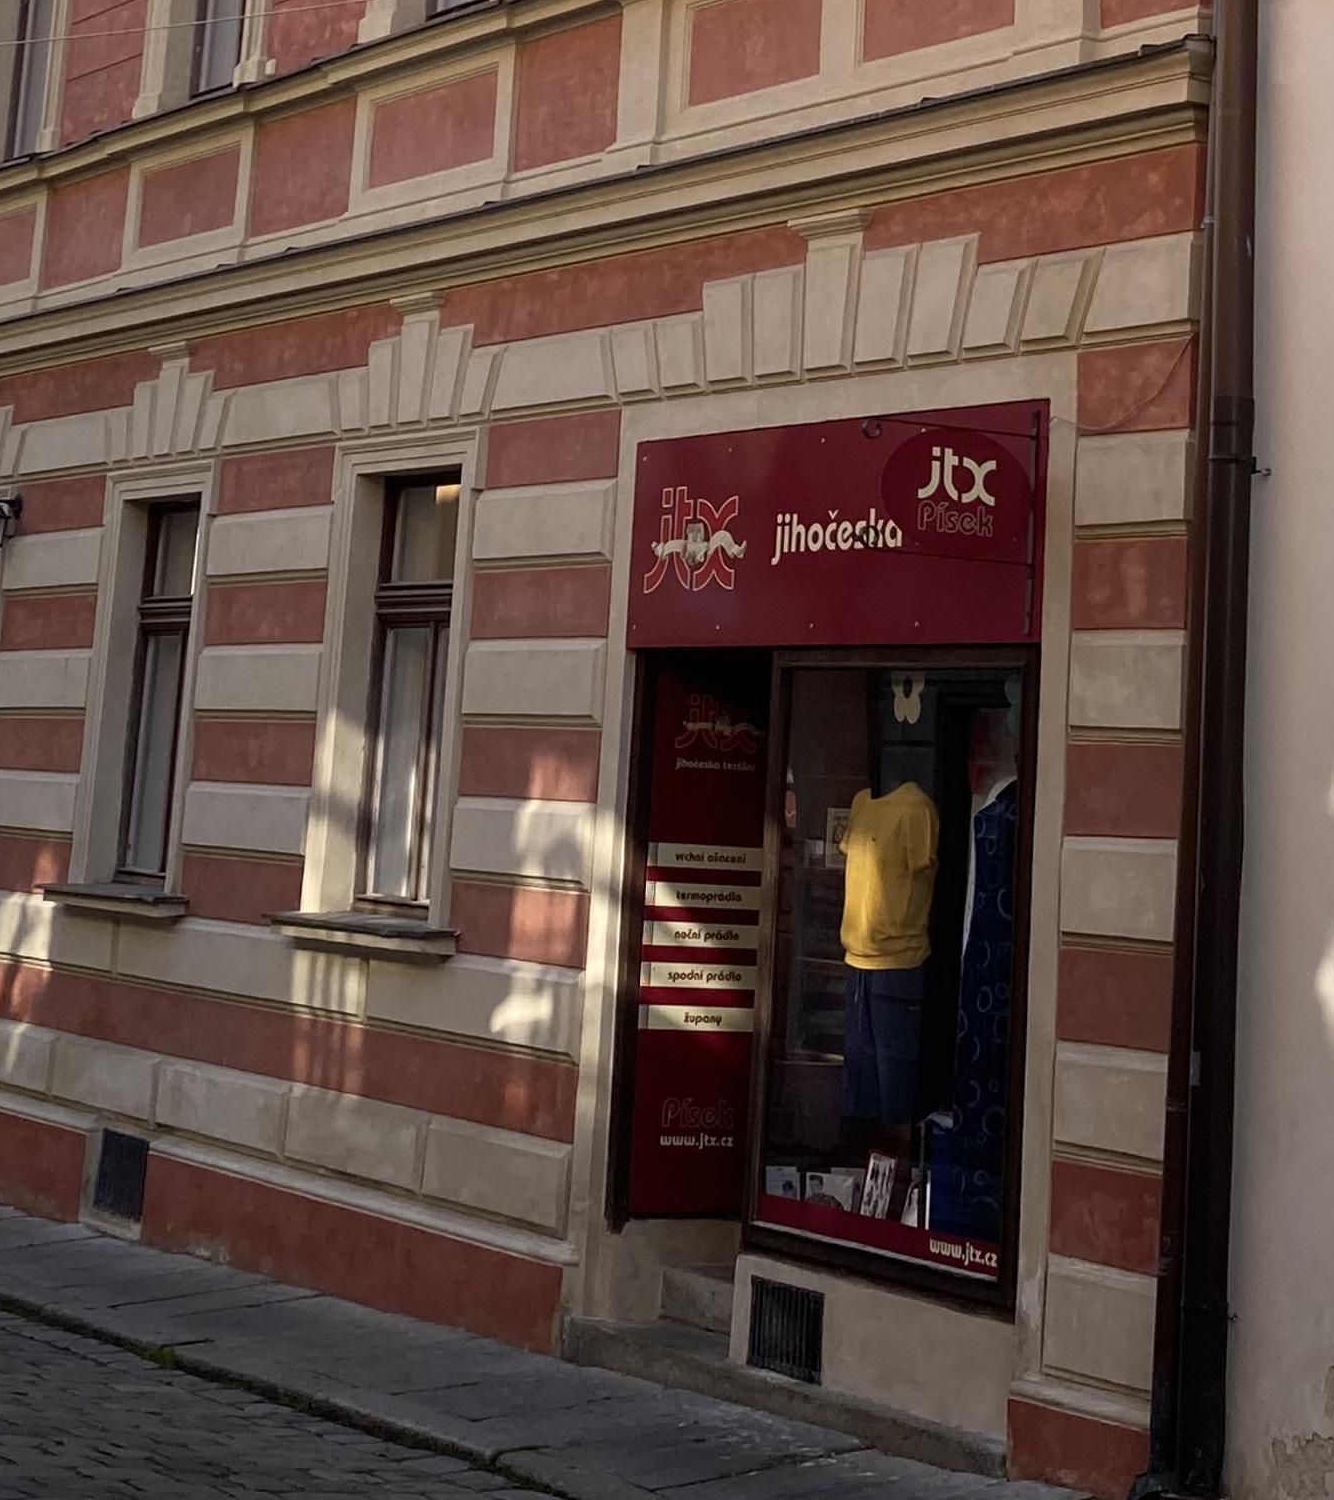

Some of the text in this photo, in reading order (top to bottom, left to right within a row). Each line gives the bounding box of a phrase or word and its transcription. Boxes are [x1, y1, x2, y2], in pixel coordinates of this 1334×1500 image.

[917, 446, 997, 507] jtx
[917, 500, 994, 537] Písek
[676, 890, 742, 904] termoprádlo
[674, 928, 740, 942] noční prádlo
[668, 969, 742, 984] spodní prádlo
[683, 1011, 722, 1026] župany
[661, 1097, 734, 1129] Písek
[660, 1132, 734, 1150] www.jtx.cz
[929, 1238, 998, 1268] www.jtx.cz
